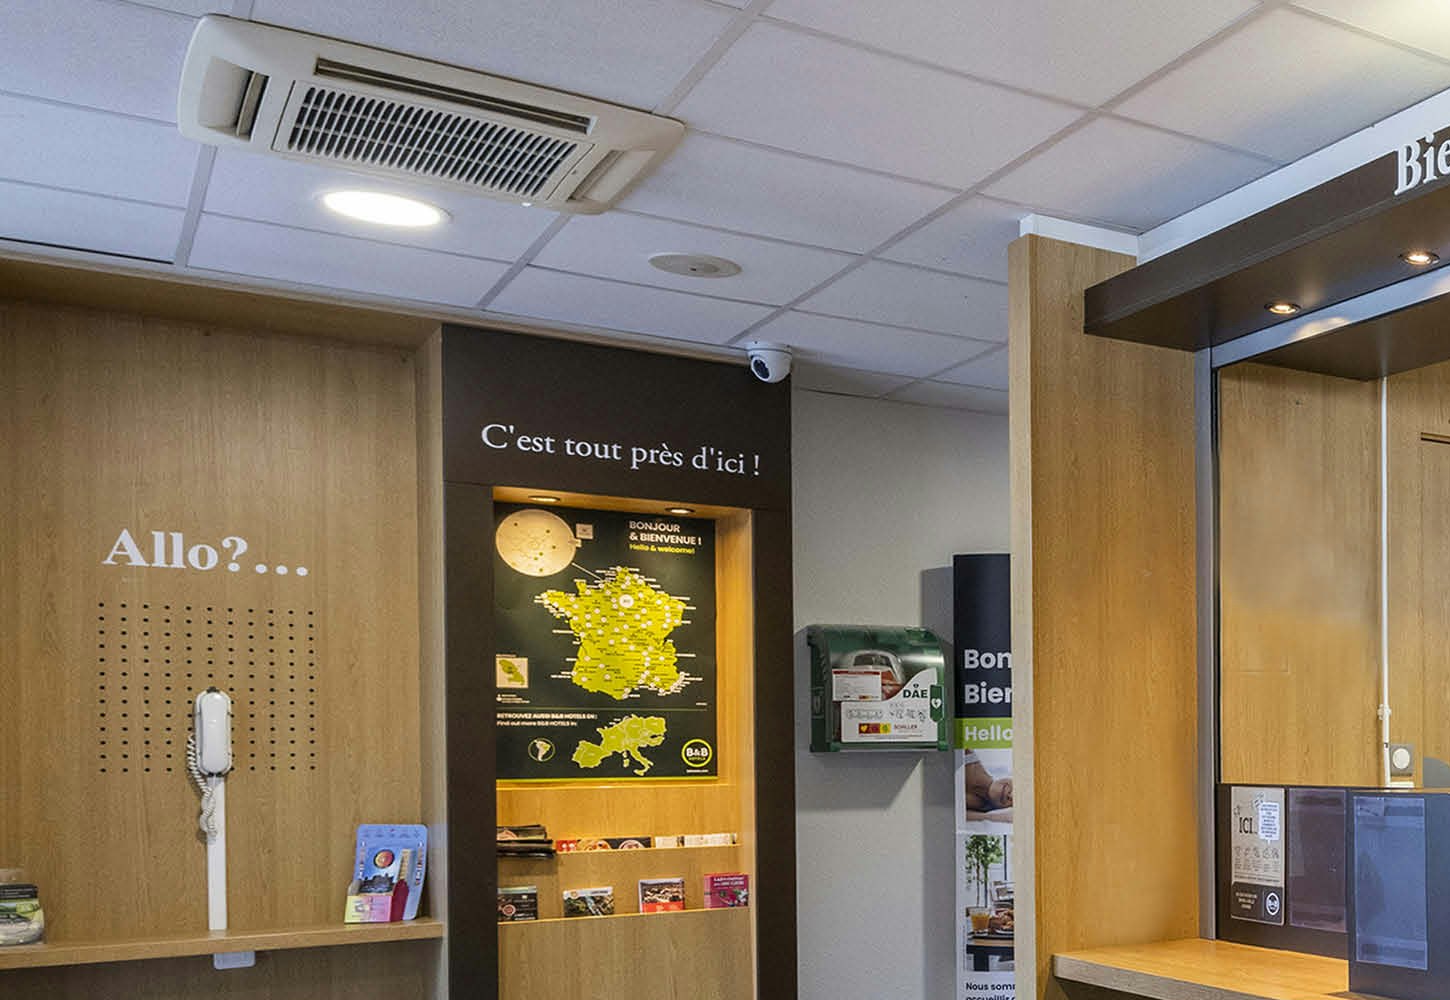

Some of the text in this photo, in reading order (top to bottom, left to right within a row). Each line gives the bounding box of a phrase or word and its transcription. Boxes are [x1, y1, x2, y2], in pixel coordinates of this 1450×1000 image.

[481, 423, 760, 476] C'est tout près d'ici !
[629, 520, 681, 532] BONJOUR
[629, 531, 638, 541] &
[640, 533, 696, 545] BIENVENUE
[964, 648, 1012, 669] Bon
[903, 688, 929, 699] DAE
[964, 725, 1013, 741] Hello
[686, 747, 708, 757] B&B
[966, 982, 988, 991] Nous
